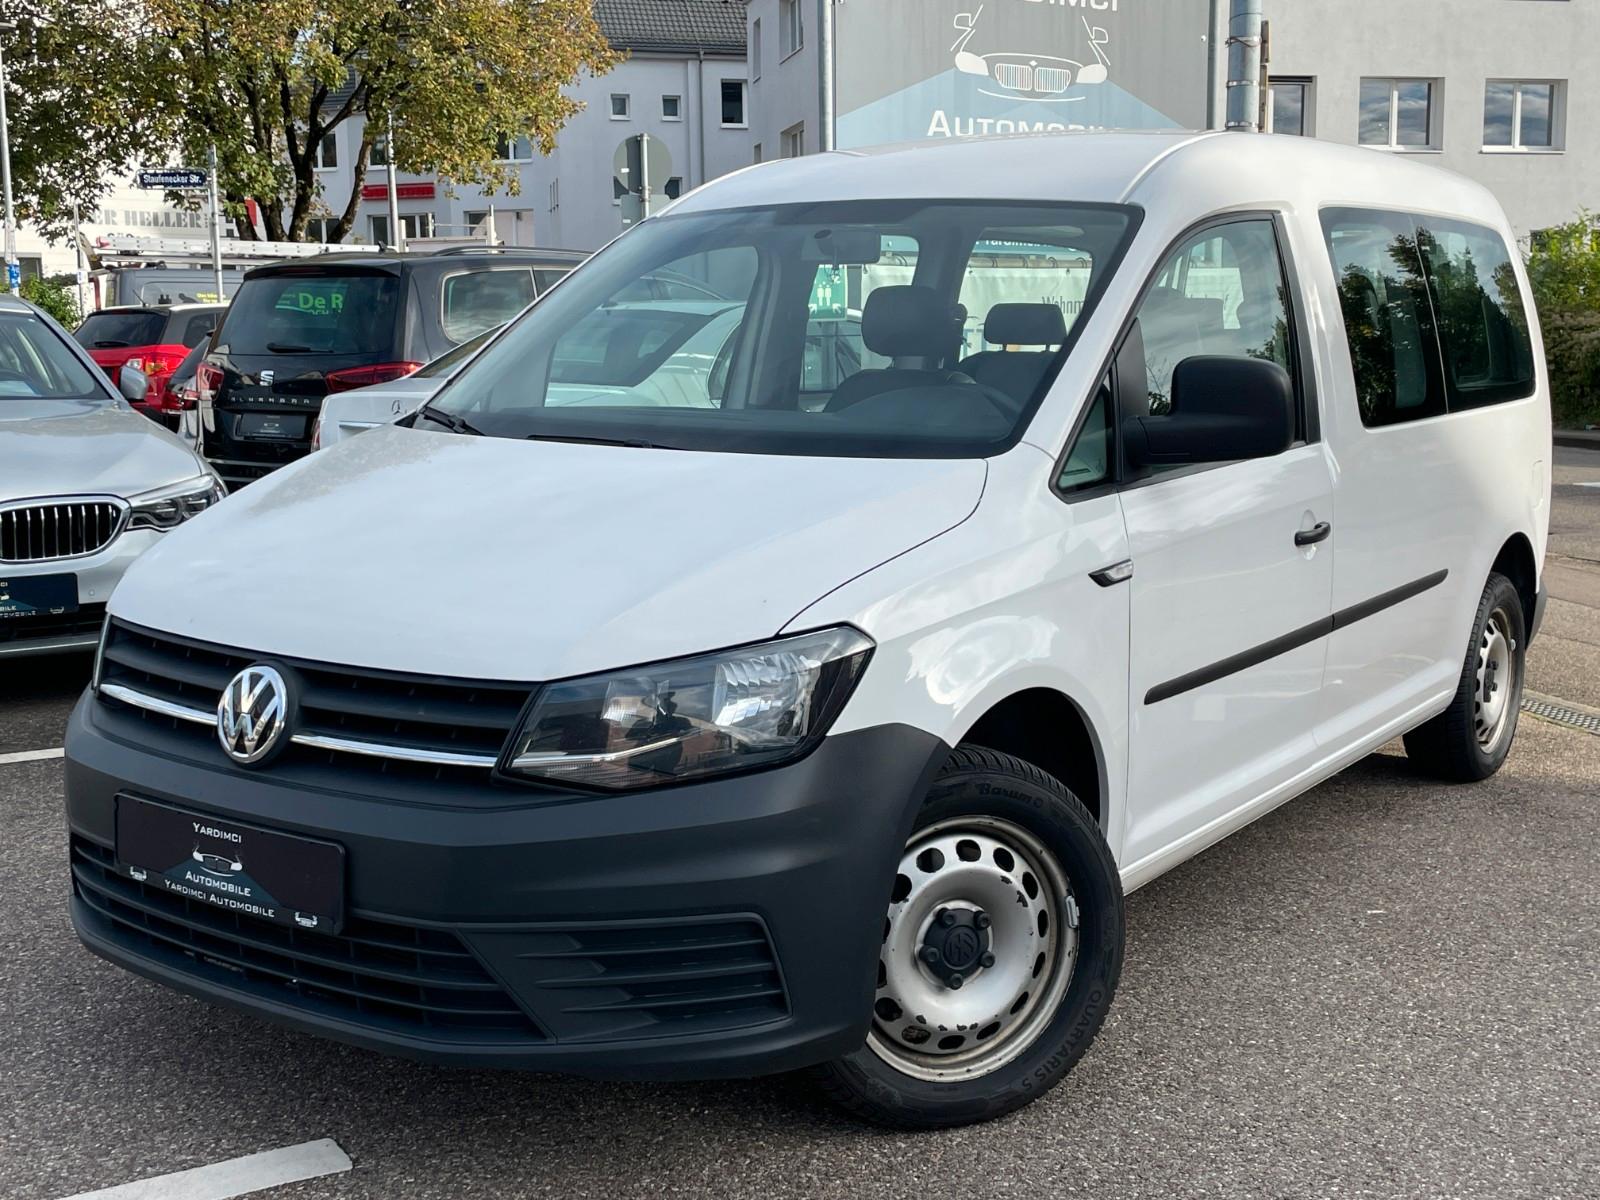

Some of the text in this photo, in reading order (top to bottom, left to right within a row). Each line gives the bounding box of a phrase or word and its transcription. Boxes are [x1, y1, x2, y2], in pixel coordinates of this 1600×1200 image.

[143, 174, 202, 183] Staufenecker Str.
[192, 822, 242, 843] YARDIMCI
[185, 870, 252, 897] AUTOMOBILE
[164, 879, 275, 918] YARDIMCI AUTOMOBILE
